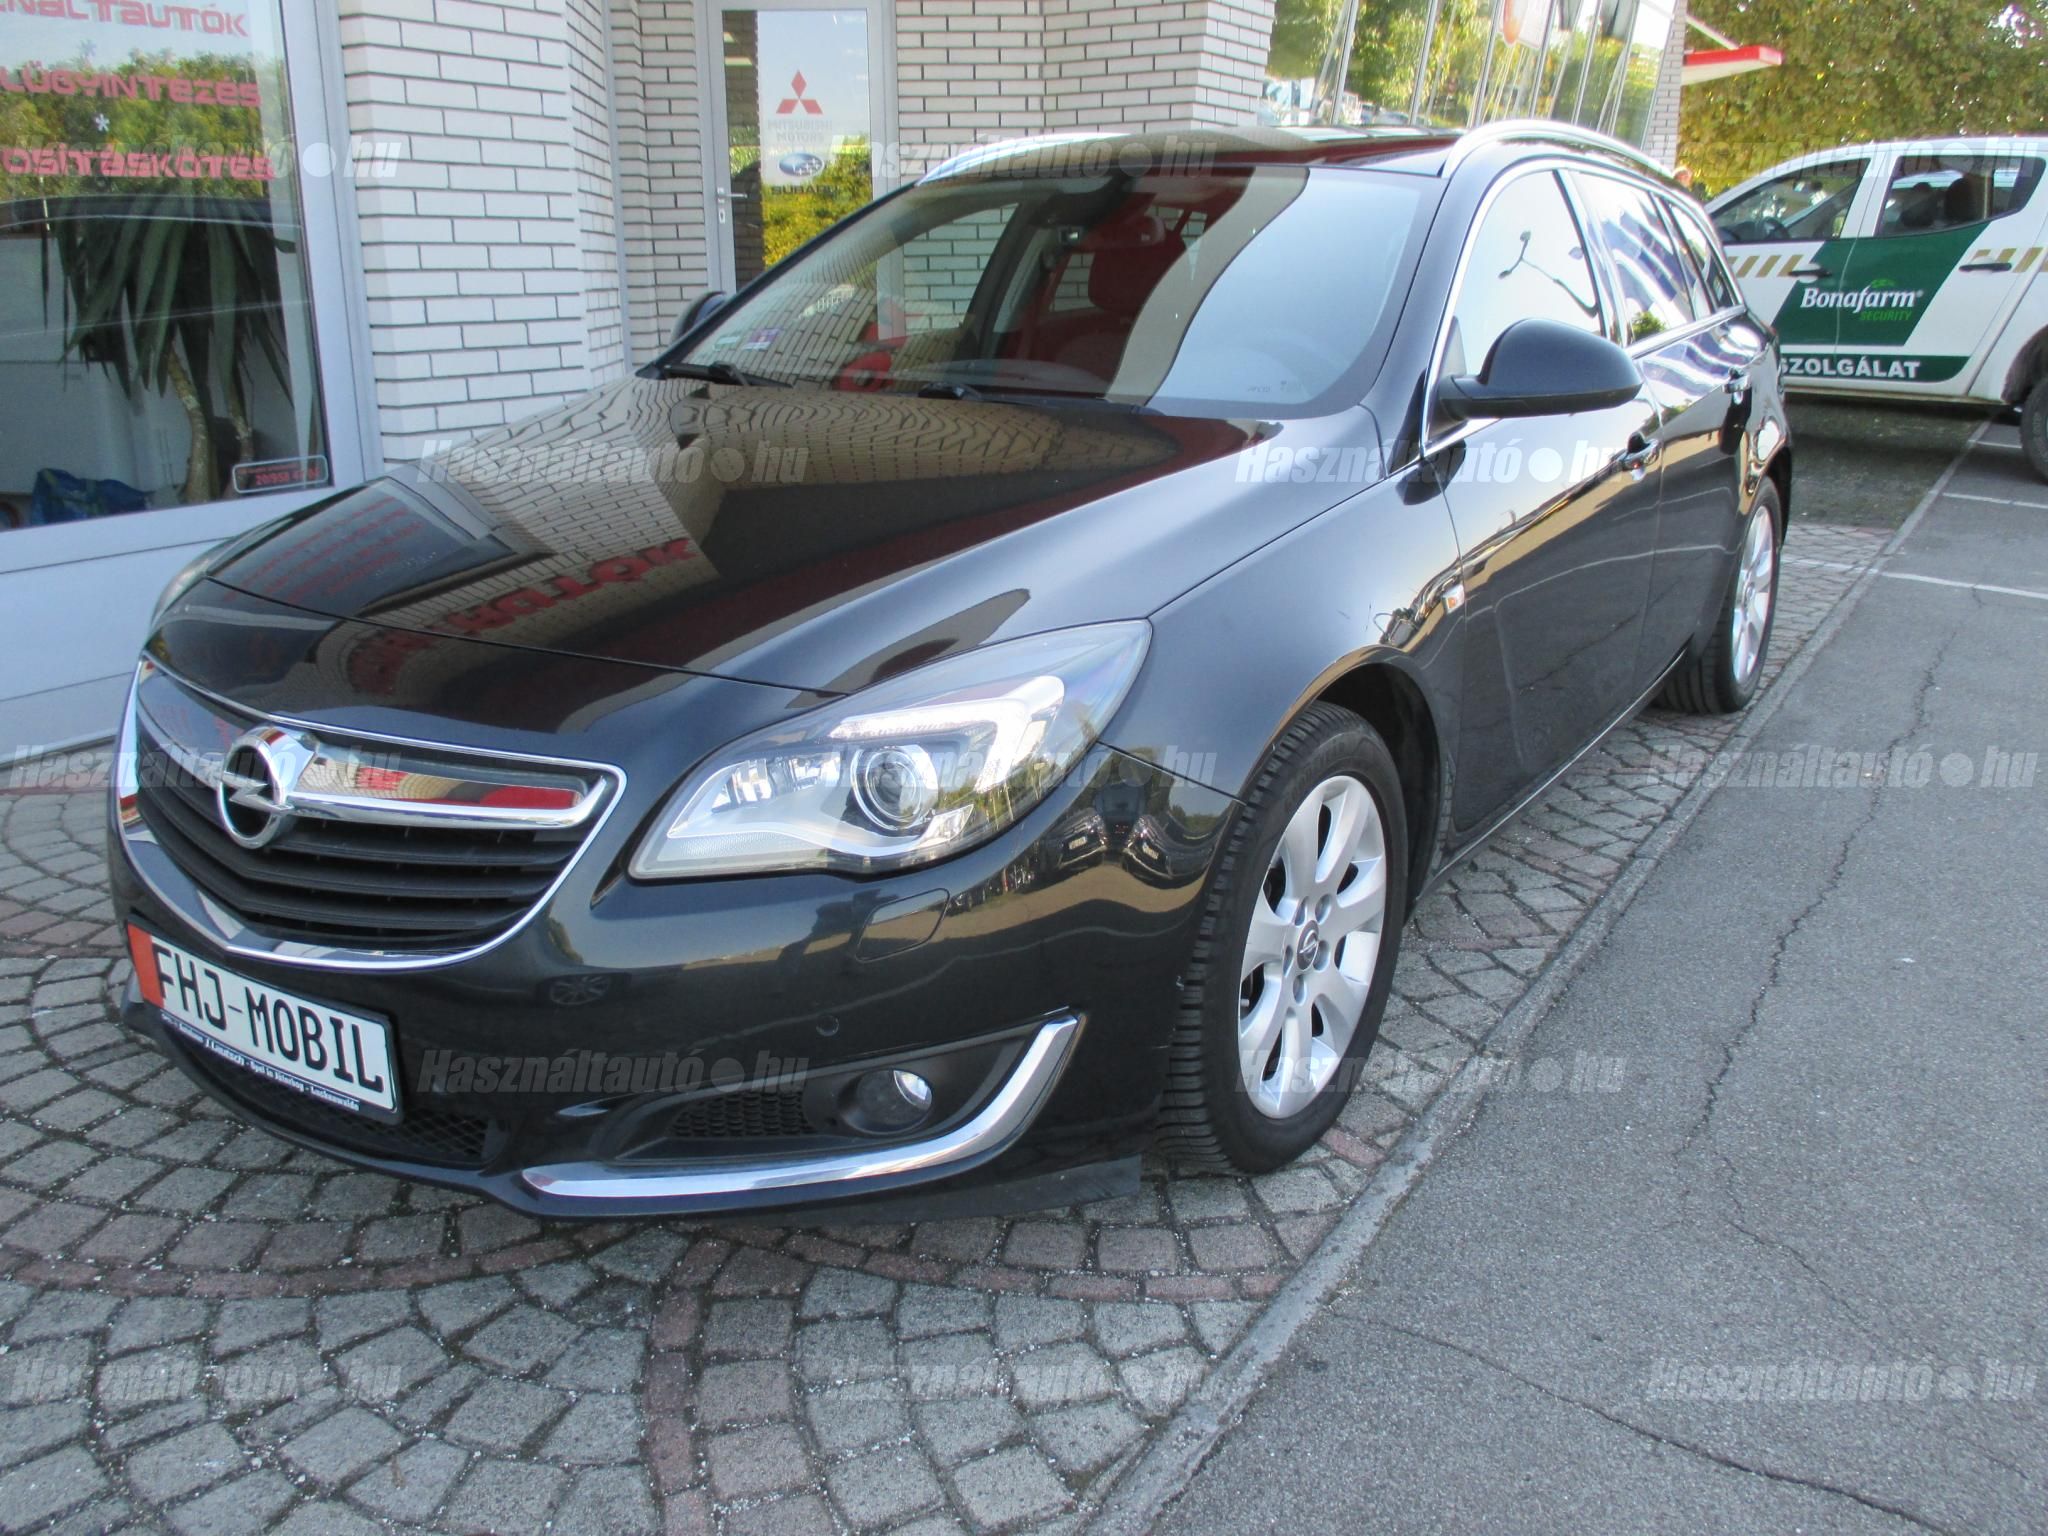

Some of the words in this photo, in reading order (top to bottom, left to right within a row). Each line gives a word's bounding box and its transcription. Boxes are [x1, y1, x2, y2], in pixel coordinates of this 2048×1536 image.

[771, 184, 838, 195] SUBARU
[1860, 310, 1913, 321] SECURITY
[152, 942, 385, 1093] FHJ-MOBIL
